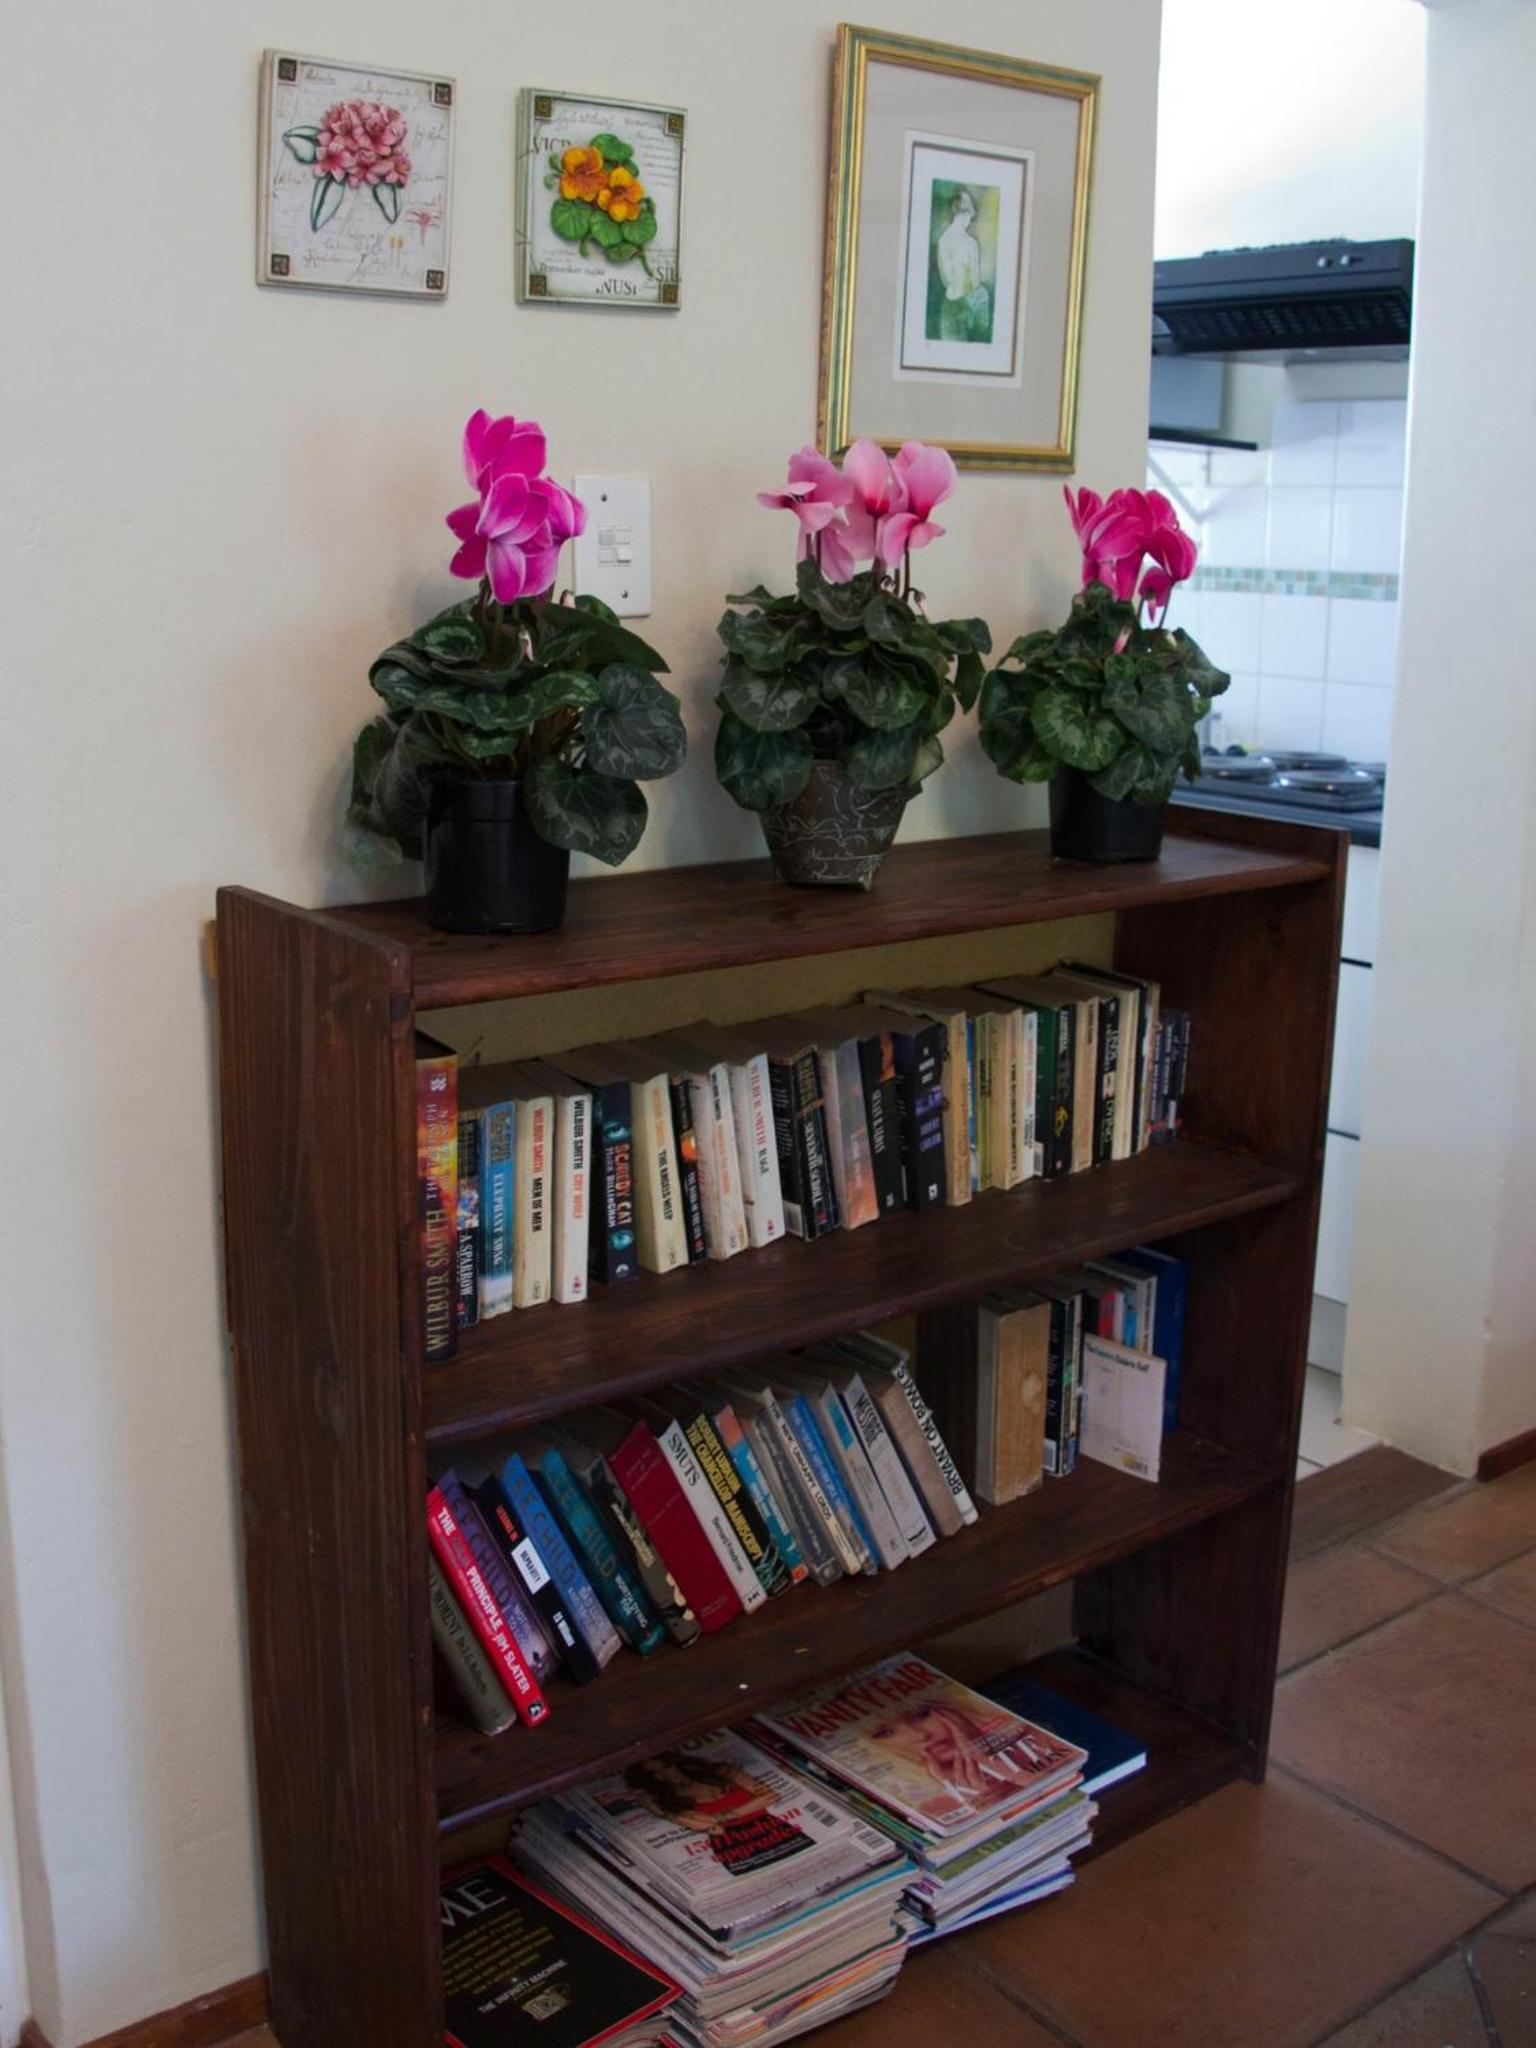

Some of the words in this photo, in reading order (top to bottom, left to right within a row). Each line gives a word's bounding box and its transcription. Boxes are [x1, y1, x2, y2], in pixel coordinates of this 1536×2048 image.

[532, 1107, 543, 1142] WILBUR
[573, 1100, 583, 1137] WILBUR
[753, 1110, 767, 1145] SMITH
[532, 1144, 543, 1173] SMITH
[573, 1139, 583, 1169] SMITH
[658, 1150, 666, 1167] THE
[757, 1148, 769, 1174] RAGE
[804, 1121, 817, 1168] SEVENTH
[532, 1177, 542, 1198] MEN
[573, 1173, 582, 1190] CRY
[613, 1143, 631, 1197] SCAREDY
[659, 1168, 669, 1198] ANGELS
[808, 1168, 821, 1204] SCROLL
[492, 1173, 504, 1232] ELEPHANT
[532, 1199, 542, 1209] OF
[573, 1194, 582, 1219] WOLF
[616, 1201, 632, 1224] CAT
[663, 1198, 672, 1220] WEEP
[426, 1208, 448, 1265] SMITH
[532, 1212, 542, 1232] MEN
[458, 1241, 472, 1296] SPARROW
[426, 1273, 449, 1352] WILBUR
[895, 1366, 926, 1418] BOWLS
[920, 1418, 939, 1441] ON
[668, 1434, 699, 1485] SMUTS
[696, 1415, 720, 1453] ROBERT
[715, 1453, 741, 1492] LUDLUM
[768, 1402, 782, 1421] THE
[780, 1424, 792, 1442] NEW
[793, 1448, 815, 1487] UNHAPPY
[814, 1492, 831, 1520] LORDS
[932, 1442, 963, 1493] BRYANT
[685, 1424, 702, 1444] THE
[695, 1443, 730, 1501] CHANCELLOR
[726, 1500, 762, 1559] MANUSCRIPT
[520, 1550, 540, 1583] DEPRAVITY
[437, 1507, 455, 1535] THE
[467, 1568, 500, 1629] PRINCIPLE
[493, 1632, 510, 1653] JIM
[504, 1652, 529, 1693] SLATER
[781, 1684, 886, 1740] VANITY
[883, 1661, 942, 1704] FAIR
[942, 1736, 1052, 1802] KATE
